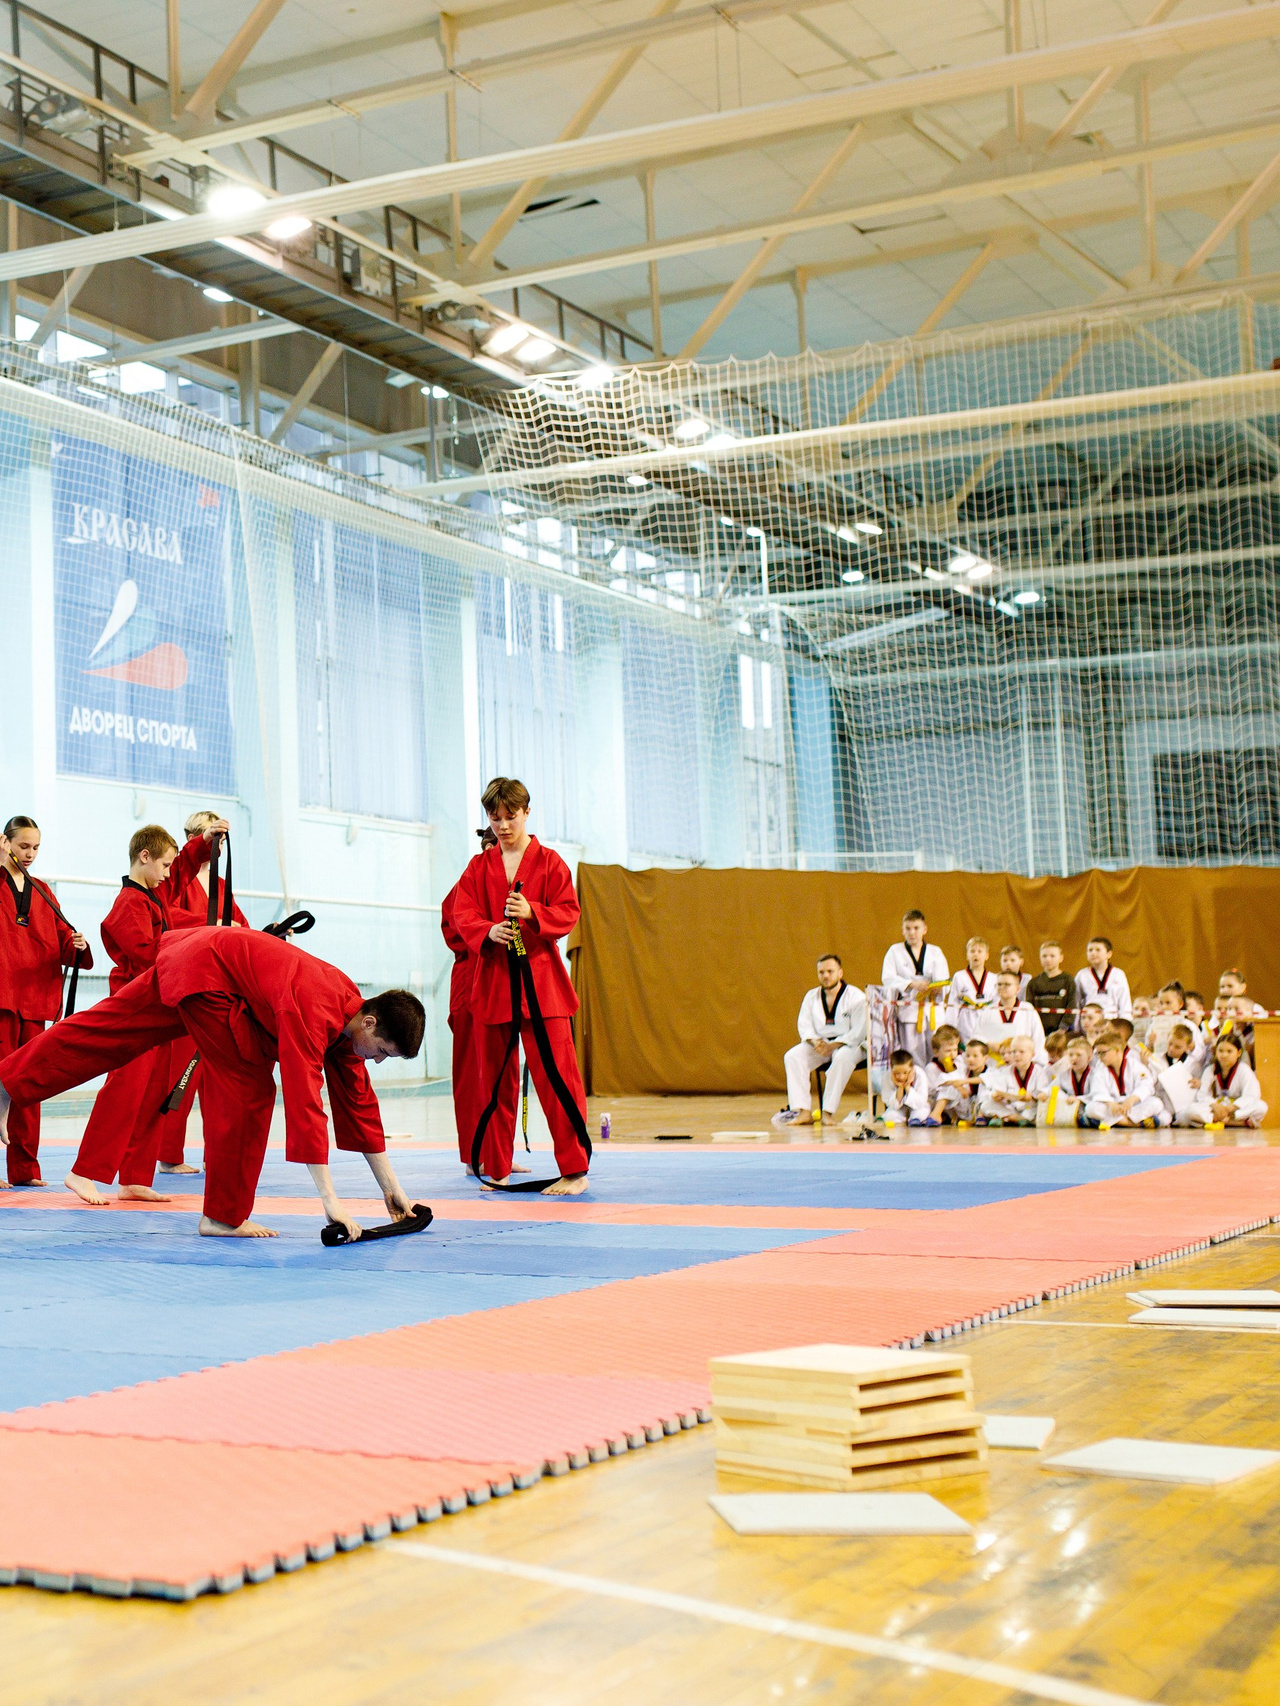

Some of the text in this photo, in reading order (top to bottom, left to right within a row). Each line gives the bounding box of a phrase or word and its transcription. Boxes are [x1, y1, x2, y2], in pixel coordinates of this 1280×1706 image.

[70, 502, 184, 566] КРАСАВА
[69, 706, 198, 752] ДВОРЕЦ СПОРТА
